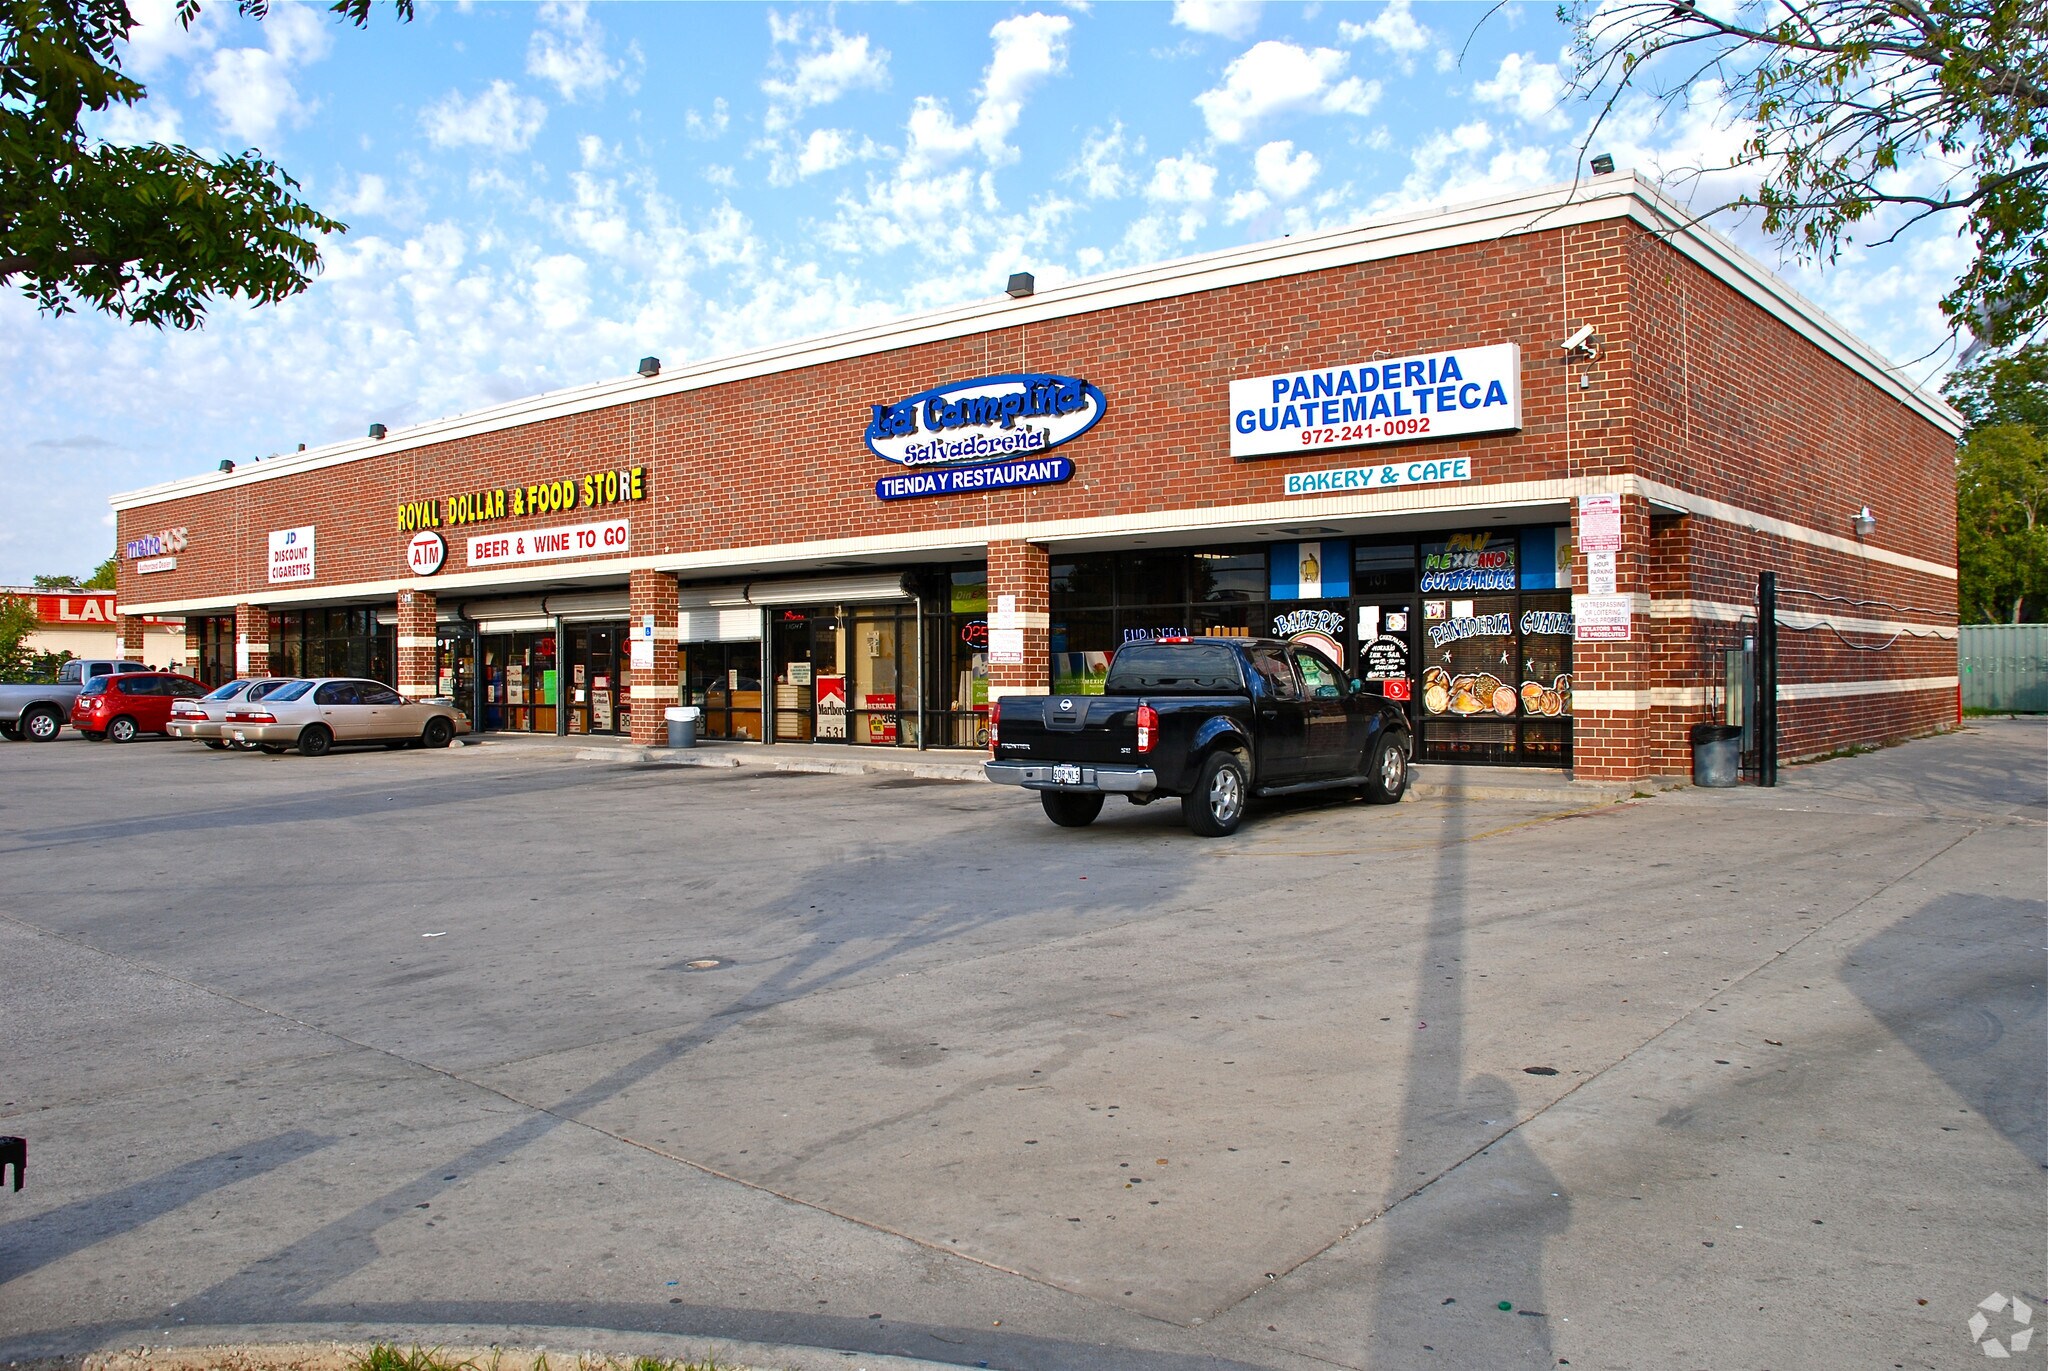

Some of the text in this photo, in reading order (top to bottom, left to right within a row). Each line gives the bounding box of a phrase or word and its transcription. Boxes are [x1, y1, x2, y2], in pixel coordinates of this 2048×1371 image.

[1272, 356, 1463, 404] PANADERIA
[870, 404, 918, 439] La
[1235, 380, 1508, 434] GUATEMALTECA
[1301, 417, 1431, 446] 972-241-0092
[882, 461, 1062, 497] TIENDA Y RESTAURANT
[1288, 459, 1467, 493] BAKERY & CAFE
[398, 499, 443, 531] ROYAL
[449, 488, 509, 525] DOLLAR
[584, 466, 646, 507] STORE
[285, 531, 297, 545] JD
[413, 539, 439, 566] ATM
[475, 526, 627, 560] BEER & WINE TO GO
[1444, 531, 1493, 551] PAN
[274, 546, 308, 563] DISCOUNT
[1425, 551, 1506, 570] MEXICANO
[272, 563, 311, 579] CIGARETTES
[1274, 609, 1345, 637] BAKERY
[1428, 613, 1513, 648] PANADERIA
[818, 701, 846, 716] Marlboro
